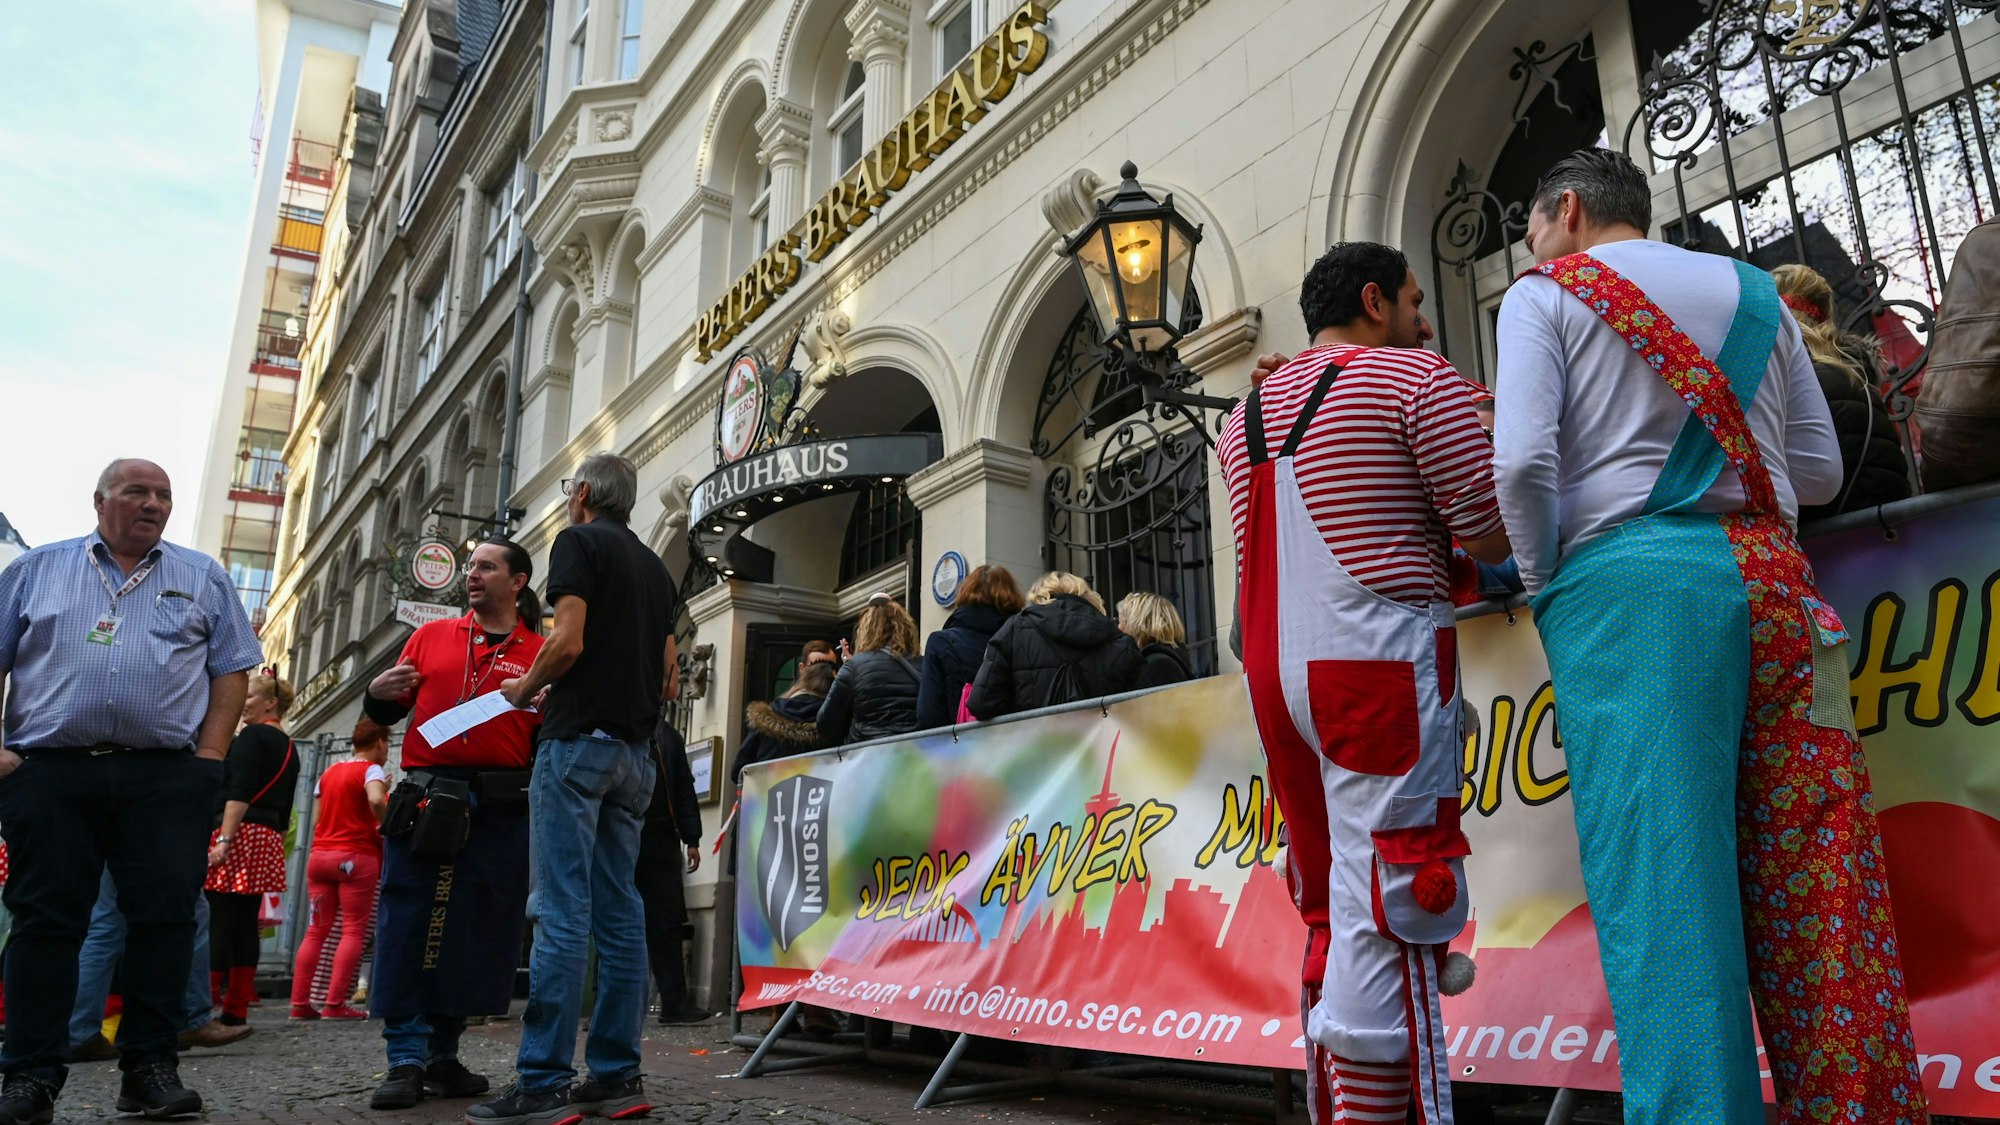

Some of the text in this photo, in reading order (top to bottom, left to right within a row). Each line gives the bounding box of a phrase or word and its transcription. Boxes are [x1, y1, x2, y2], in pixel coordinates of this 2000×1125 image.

[694, 1, 1049, 364] PETERS BRAUHAUS
[726, 391, 755, 424] TERS
[414, 604, 448, 616] PETERS
[501, 660, 526, 672] PETERS
[800, 786, 825, 913] INNOSEC
[855, 849, 970, 923] JECK,
[980, 797, 1178, 908] ÄVVER
[422, 906, 447, 971] PETERS
[923, 980, 1243, 1043] info@inno.sec.com
